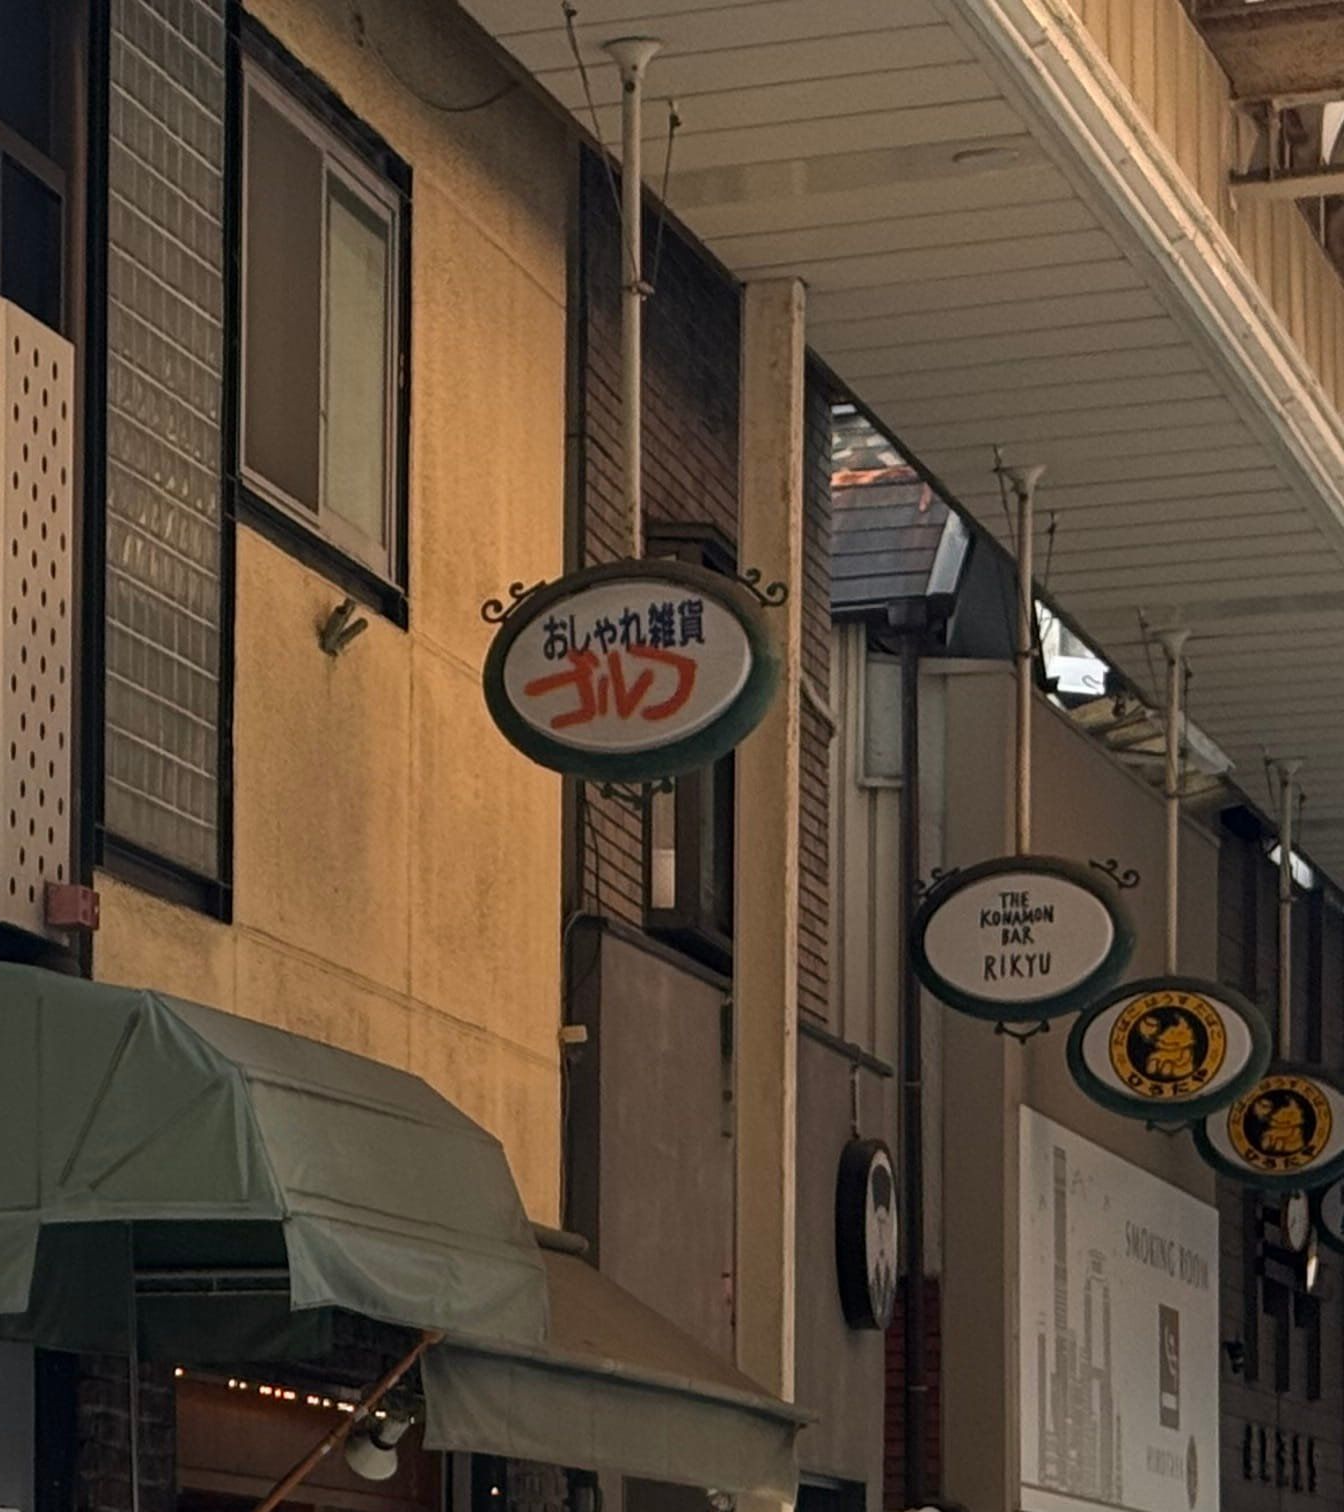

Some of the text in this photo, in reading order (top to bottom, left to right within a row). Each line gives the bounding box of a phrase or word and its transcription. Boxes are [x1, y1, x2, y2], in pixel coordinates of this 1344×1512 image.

[542, 600, 705, 661] おしゃれ雑貨
[524, 645, 698, 730] ゴルフ
[999, 891, 1029, 909] THE
[980, 904, 1054, 928] KONAMON
[1002, 926, 1034, 946] BAR
[984, 952, 1051, 981] RIKYU
